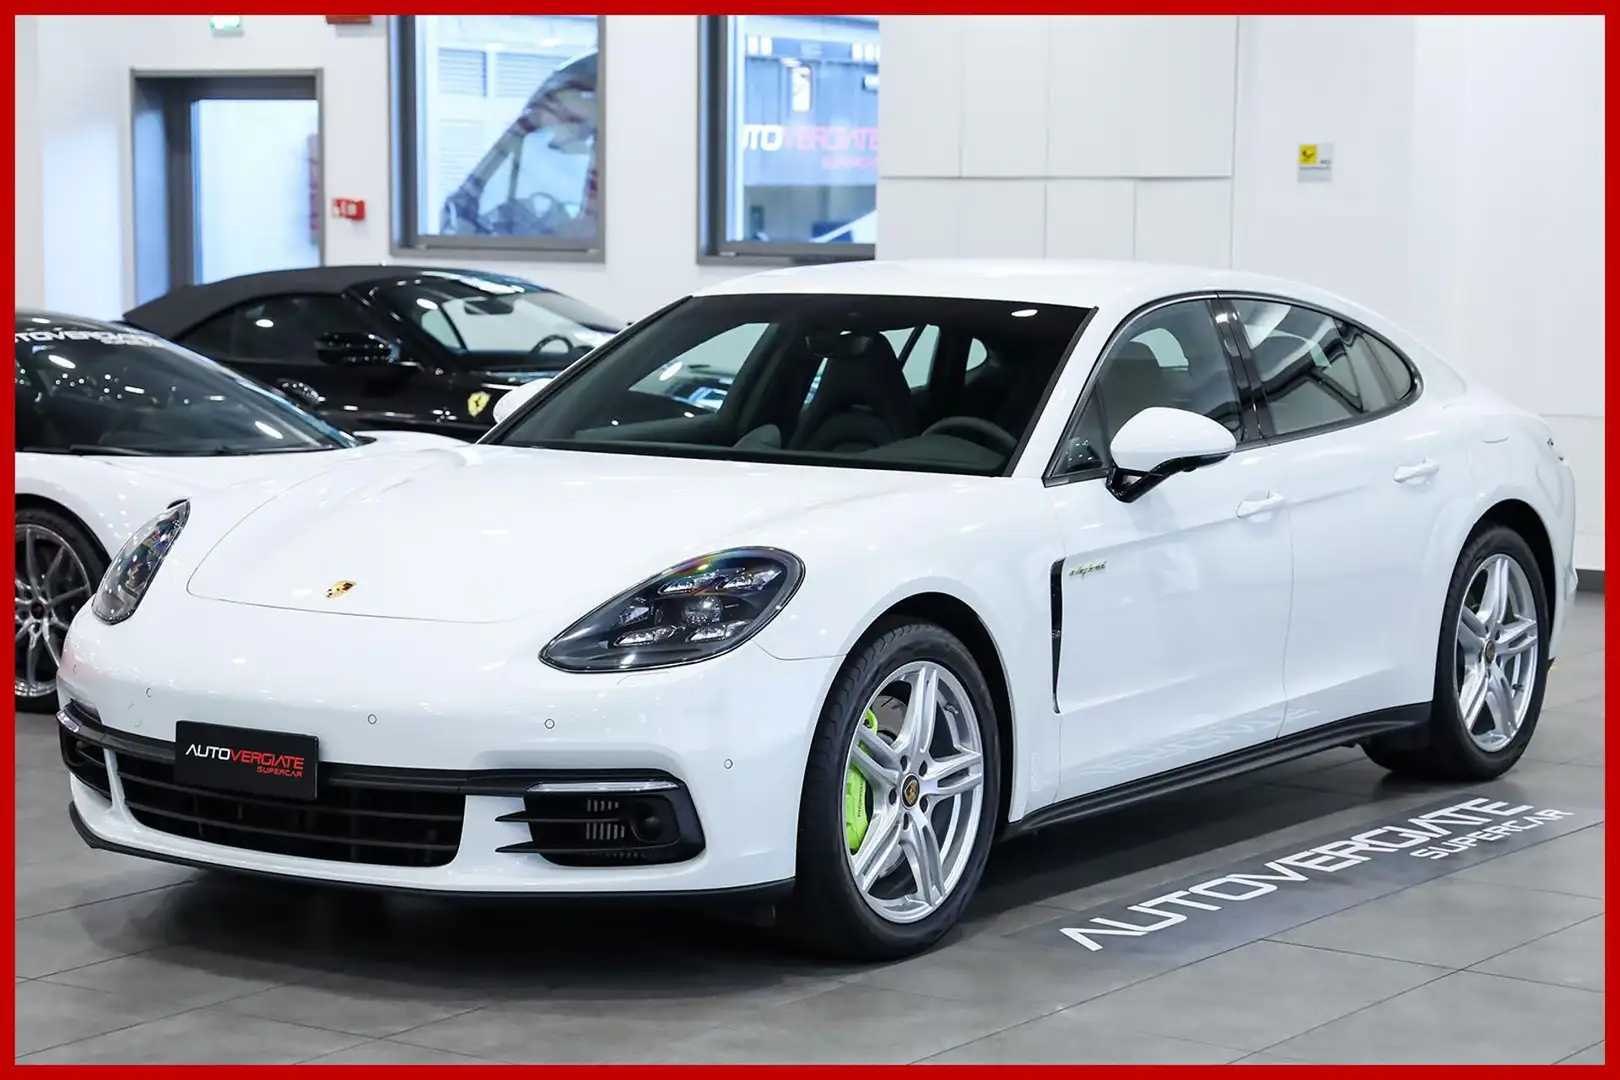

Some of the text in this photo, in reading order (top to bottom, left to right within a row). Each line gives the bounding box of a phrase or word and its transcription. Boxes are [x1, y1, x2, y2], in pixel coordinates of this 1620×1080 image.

[185, 743, 305, 770] AUTOVERGIATE
[257, 765, 303, 778] SUPERCAR
[1409, 808, 1575, 860] SUPERCAR
[1060, 797, 1535, 951] AUTOVERGIATE
